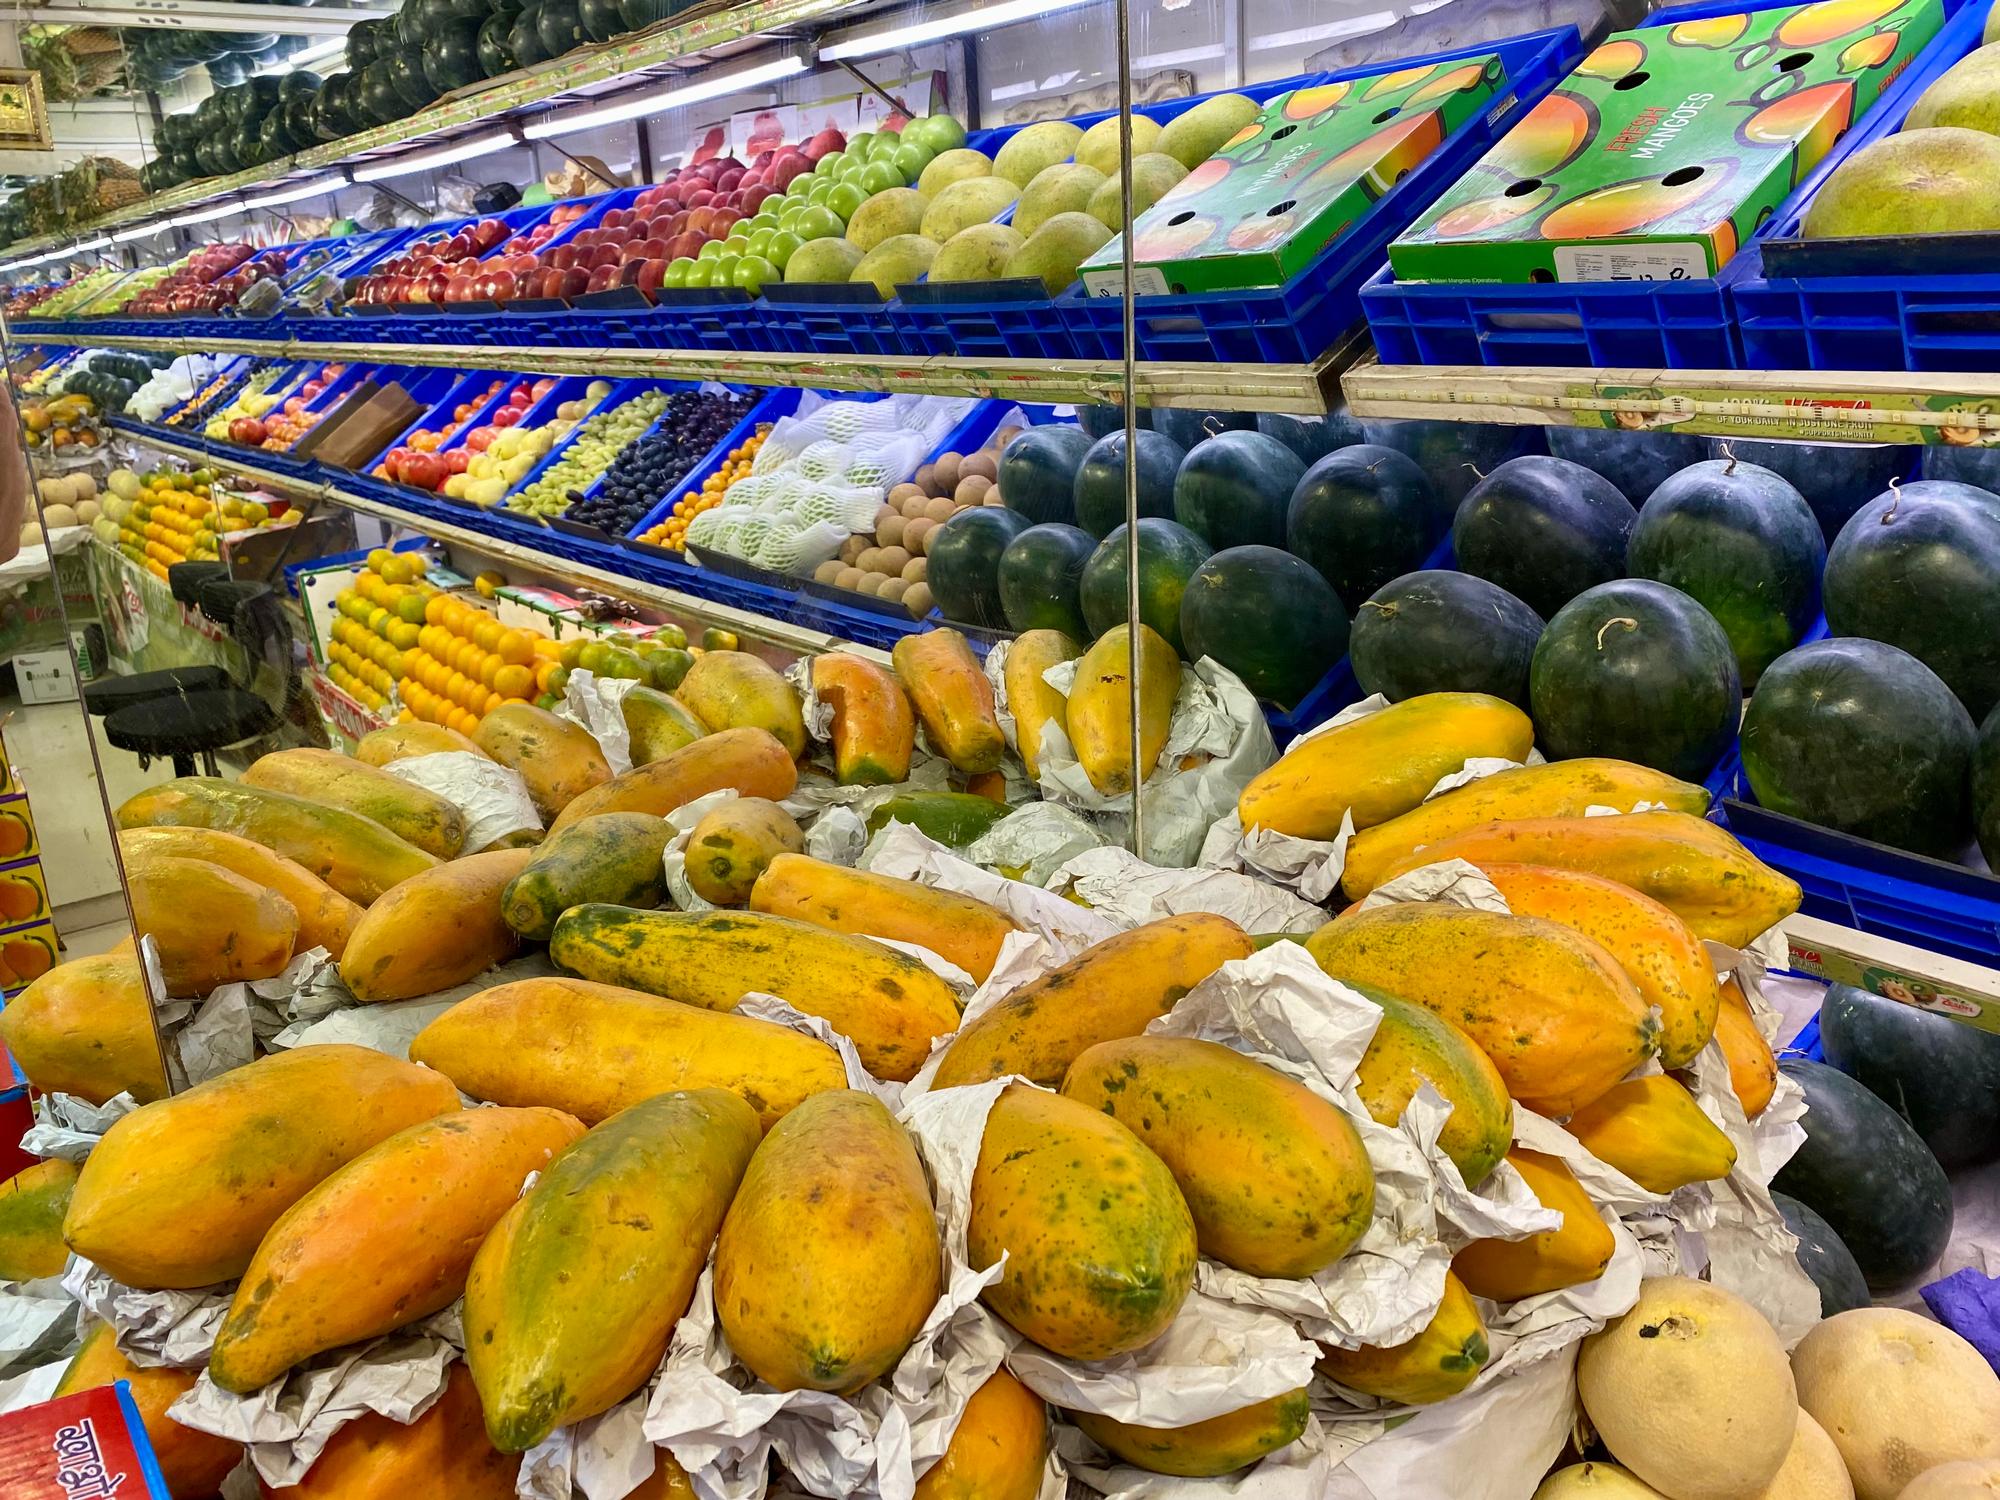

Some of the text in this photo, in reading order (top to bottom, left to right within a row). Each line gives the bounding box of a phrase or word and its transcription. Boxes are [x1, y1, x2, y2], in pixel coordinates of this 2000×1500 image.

[1604, 107, 1669, 152] FRESH
[1630, 93, 1714, 159] MANGOES
[1731, 416, 1752, 425] YOUR
[1755, 417, 1781, 426] DAILY
[1800, 420, 1823, 428] JUST
